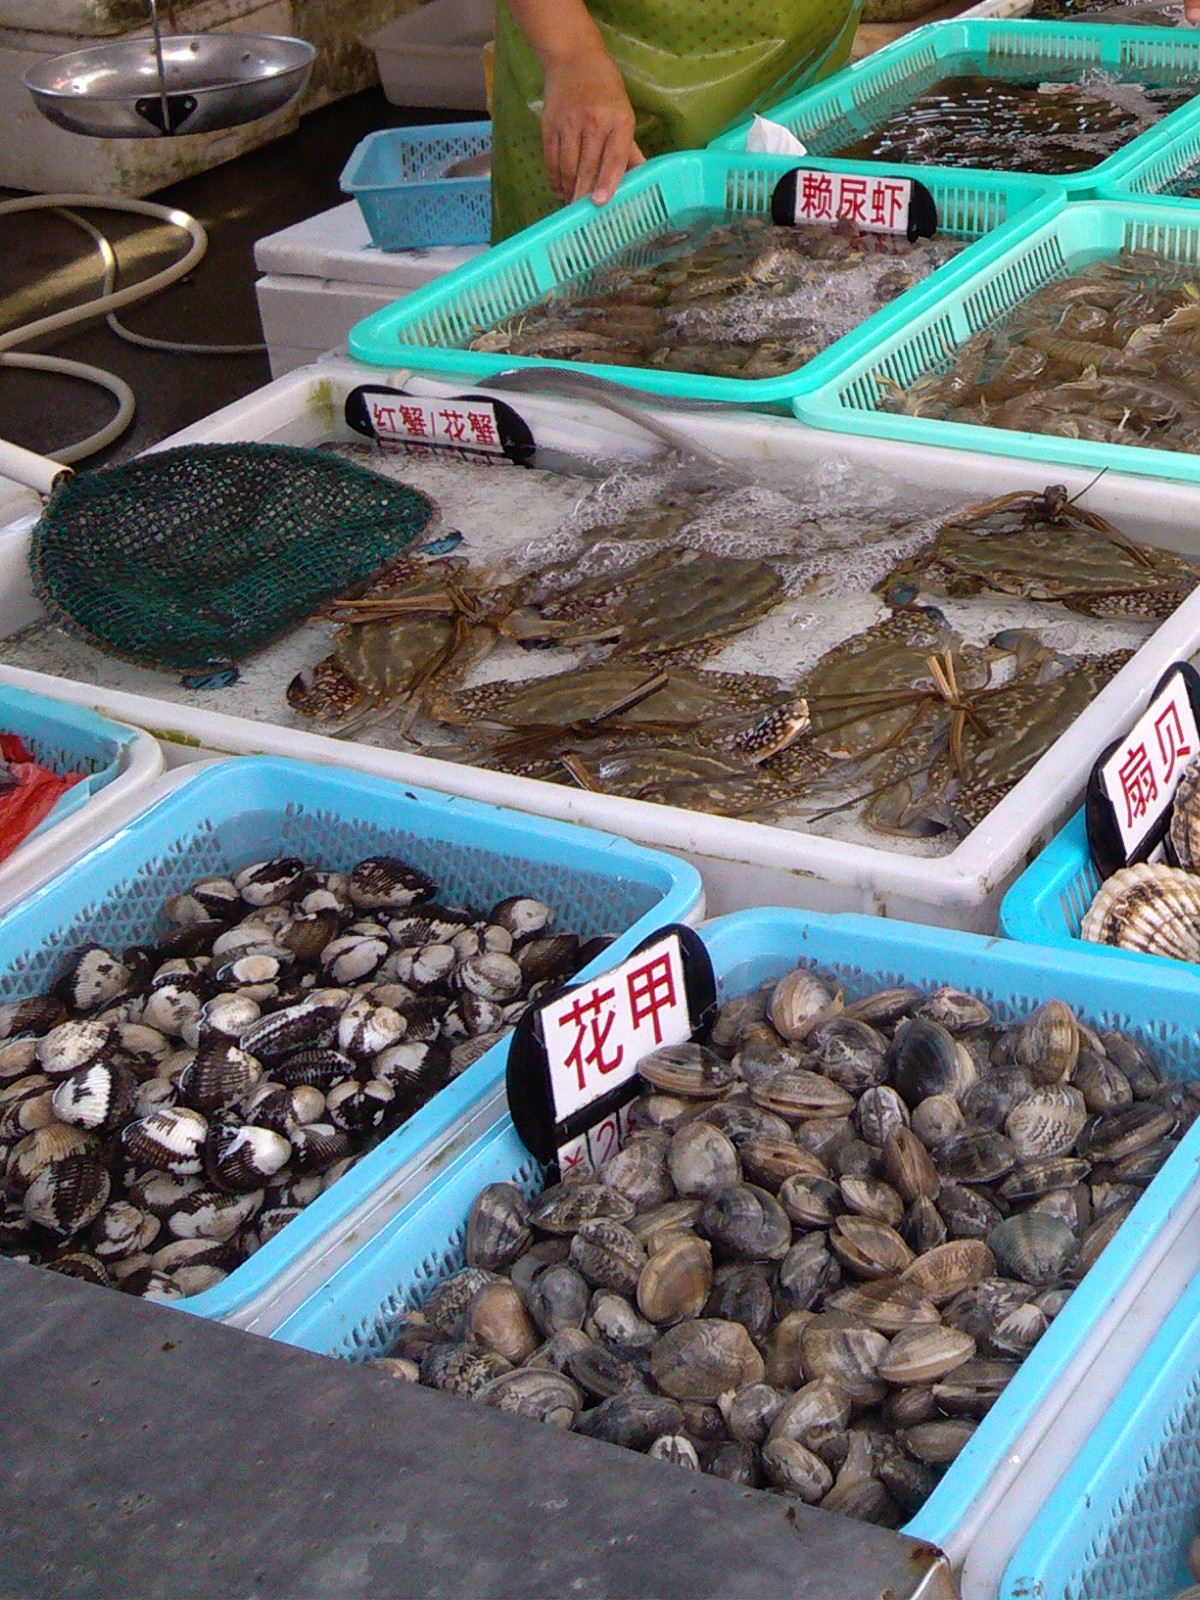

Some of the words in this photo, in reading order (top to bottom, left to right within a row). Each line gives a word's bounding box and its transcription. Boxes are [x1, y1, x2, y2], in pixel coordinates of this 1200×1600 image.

[801, 173, 904, 228] 赖尿虾
[372, 403, 498, 446] 红蟹/花蟹
[1118, 699, 1191, 829] 扇贝
[558, 951, 677, 1091] 花甲
